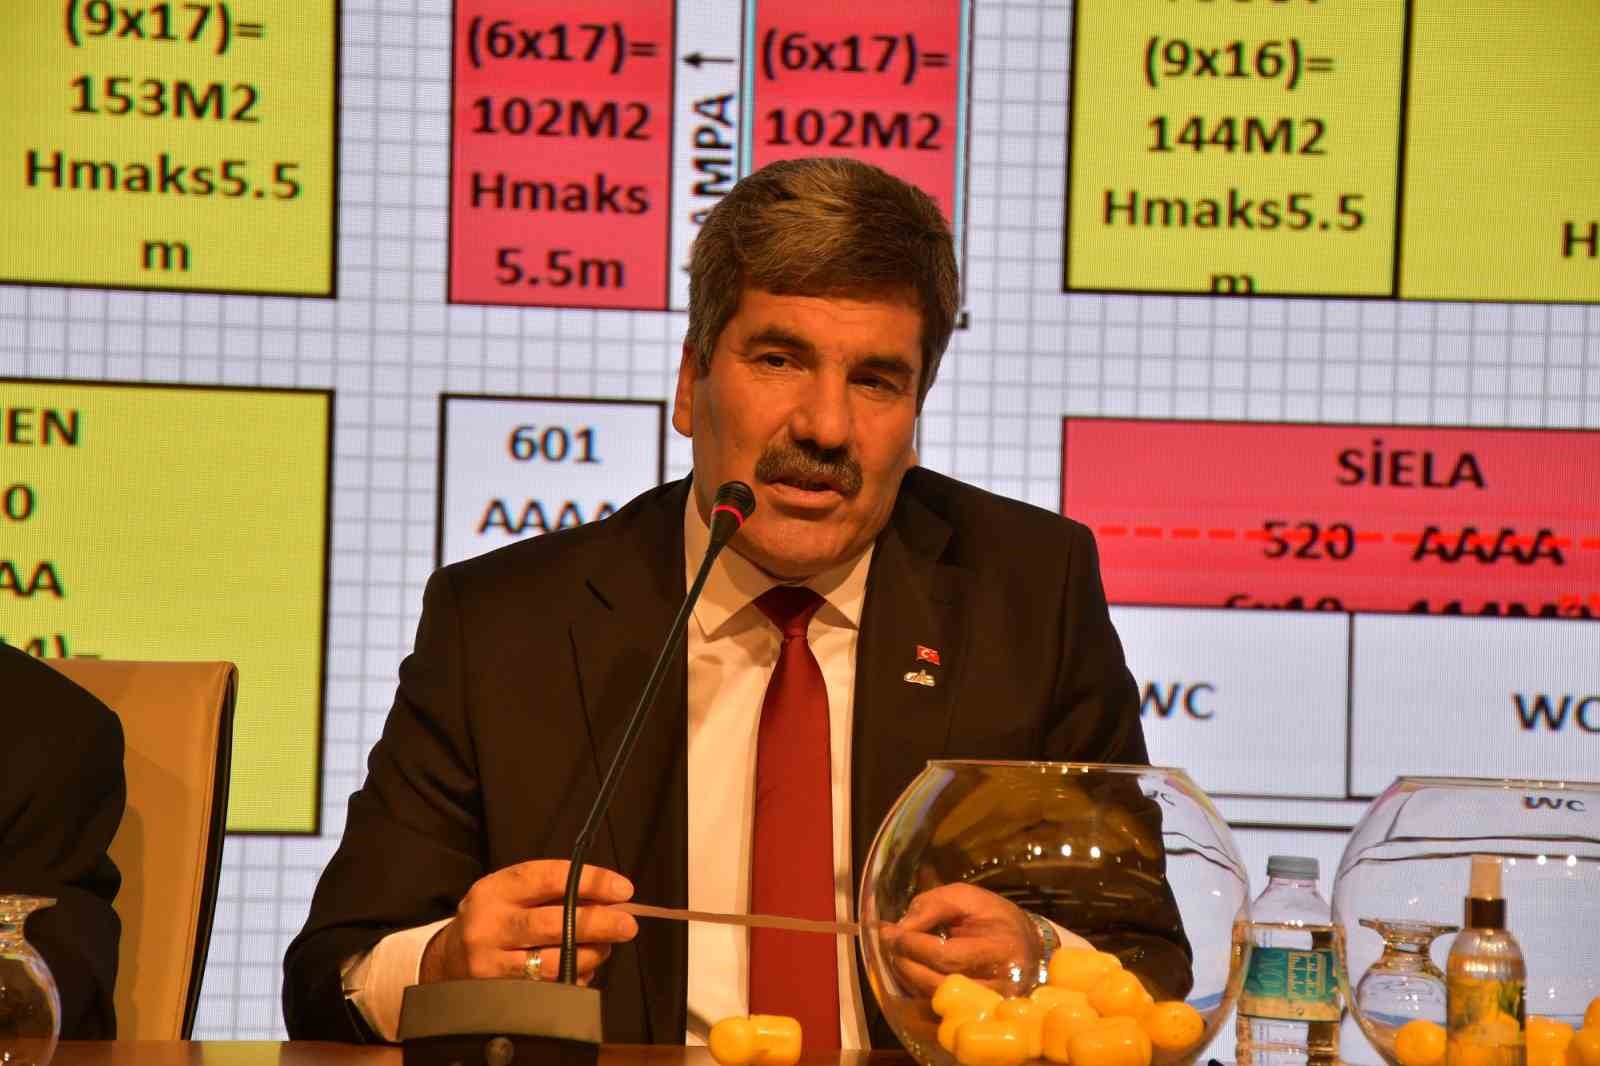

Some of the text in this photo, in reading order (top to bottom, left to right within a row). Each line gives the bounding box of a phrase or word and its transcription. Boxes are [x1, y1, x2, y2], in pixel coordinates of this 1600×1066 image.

[66, 0, 264, 55] (9x17)=
[467, 15, 657, 75] (6x17)=
[762, 28, 949, 85] (6x17)=
[1145, 35, 1335, 90] (9x16)=
[70, 74, 260, 123] 153M2
[472, 96, 651, 140] 102M2
[767, 109, 942, 151] 102M2
[1148, 115, 1327, 156] 144M2
[26, 149, 302, 200] Hmaks5.5
[471, 172, 650, 215] Hmaks
[1103, 188, 1366, 232] Hmaks5.5
[143, 240, 191, 273] m
[496, 247, 625, 290] 5.5m
[509, 425, 600, 464] 601
[1336, 439, 1486, 489] SİELA
[1263, 520, 1565, 566] 520 AAAA
